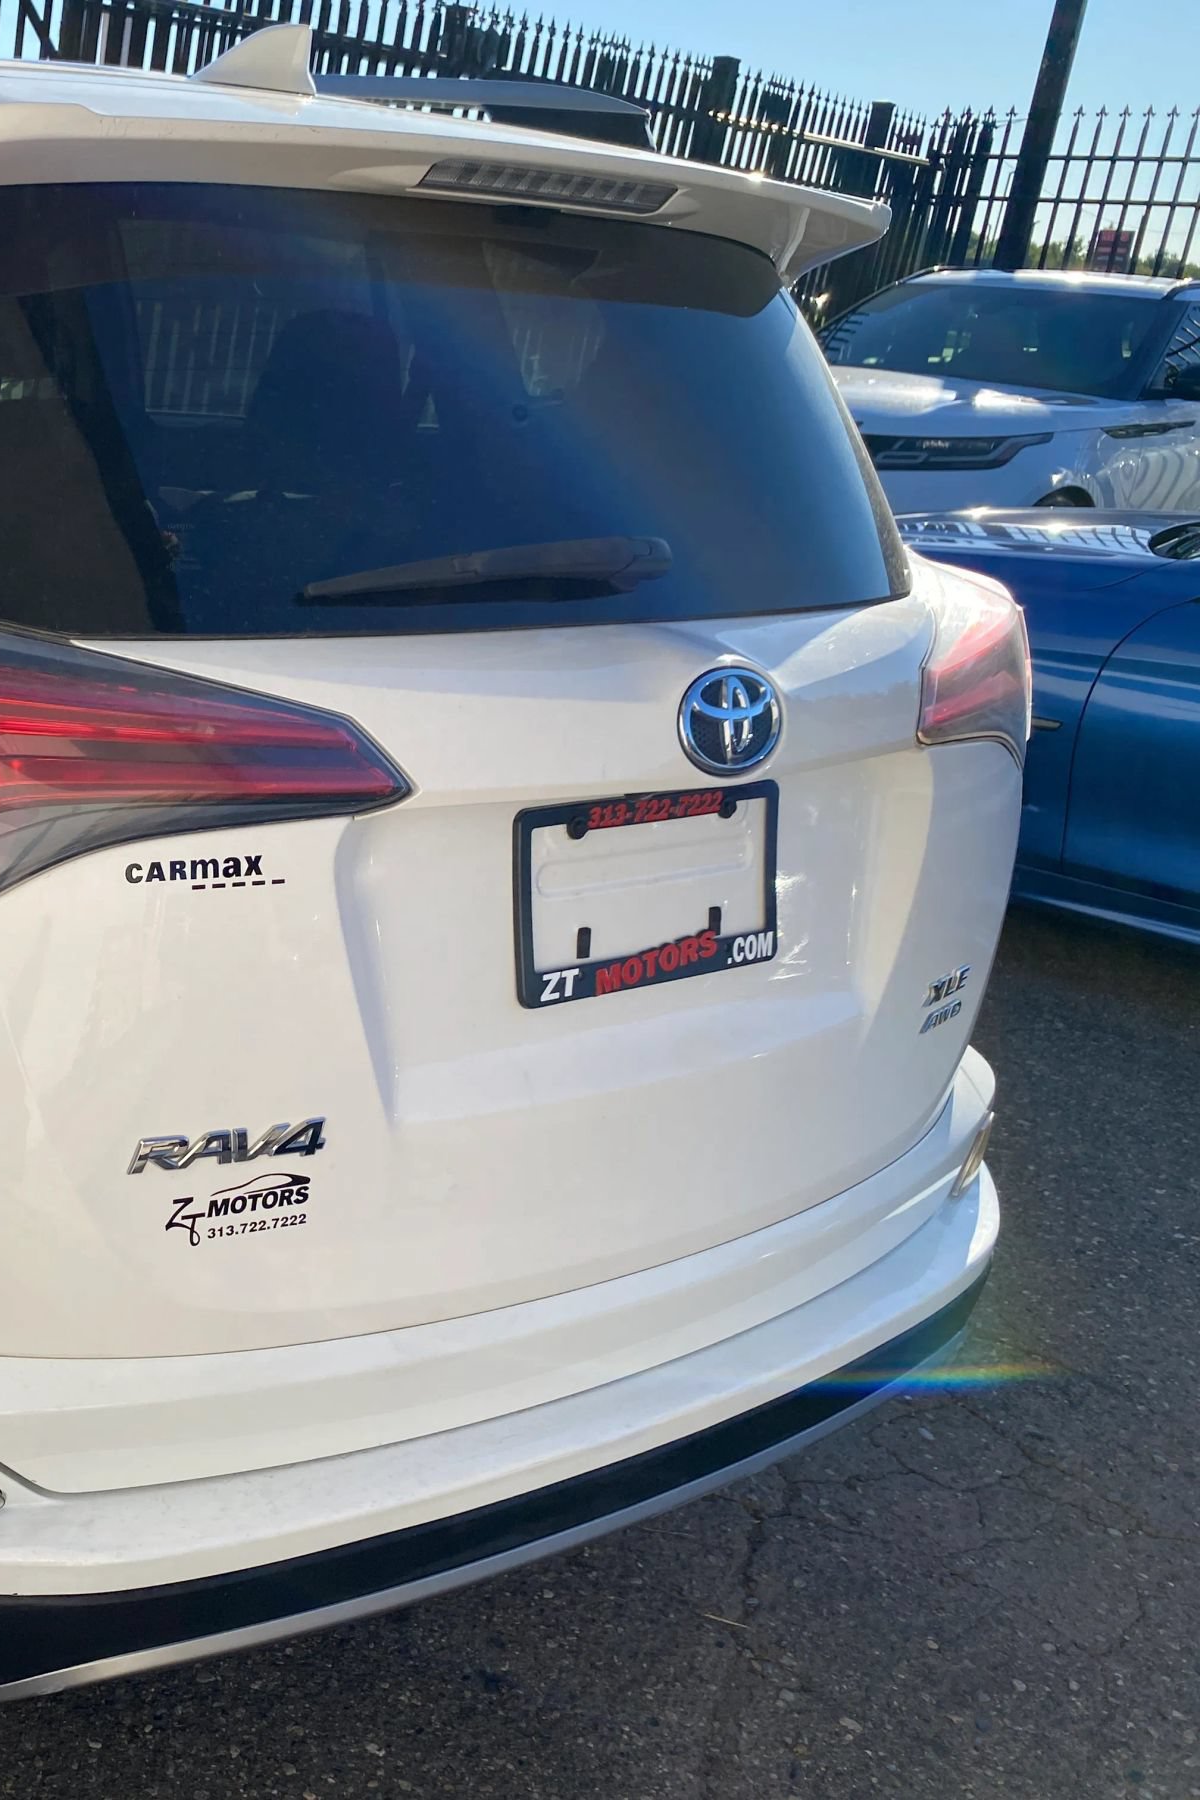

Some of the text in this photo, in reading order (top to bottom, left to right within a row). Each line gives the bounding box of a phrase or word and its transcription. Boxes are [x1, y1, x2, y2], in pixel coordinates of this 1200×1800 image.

[587, 791, 724, 830] 313-722-7222
[125, 855, 263, 884] CARmax
[540, 930, 774, 1002] ZT MOTORS .COM
[921, 963, 971, 1008] XLE
[919, 998, 963, 1034] AWD
[127, 1116, 327, 1175] RAV4
[207, 1185, 310, 1219] MOTORS
[207, 1213, 308, 1239] 313.722.7222
